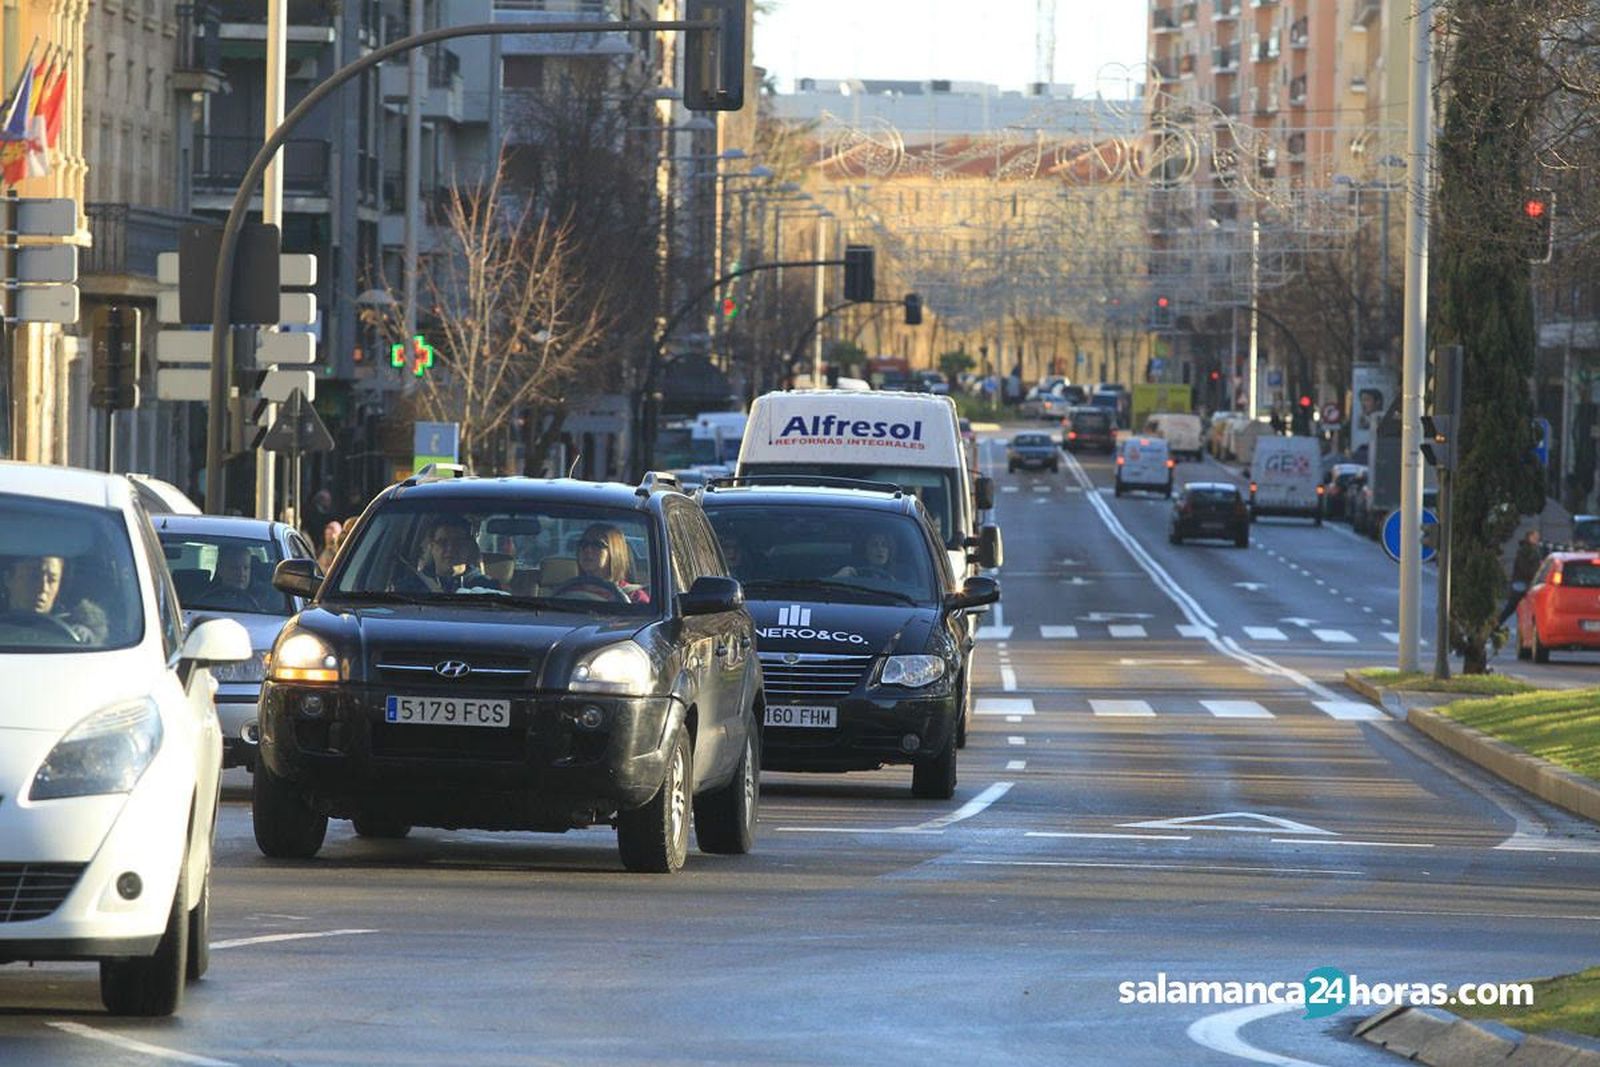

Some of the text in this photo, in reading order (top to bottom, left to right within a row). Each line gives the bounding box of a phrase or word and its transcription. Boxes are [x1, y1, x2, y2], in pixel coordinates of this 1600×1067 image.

[780, 415, 922, 441] Alfresol
[775, 437, 925, 449] REFORMAS INTEGRALES
[401, 700, 504, 723] 5179 FCS
[800, 709, 831, 725] FHM
